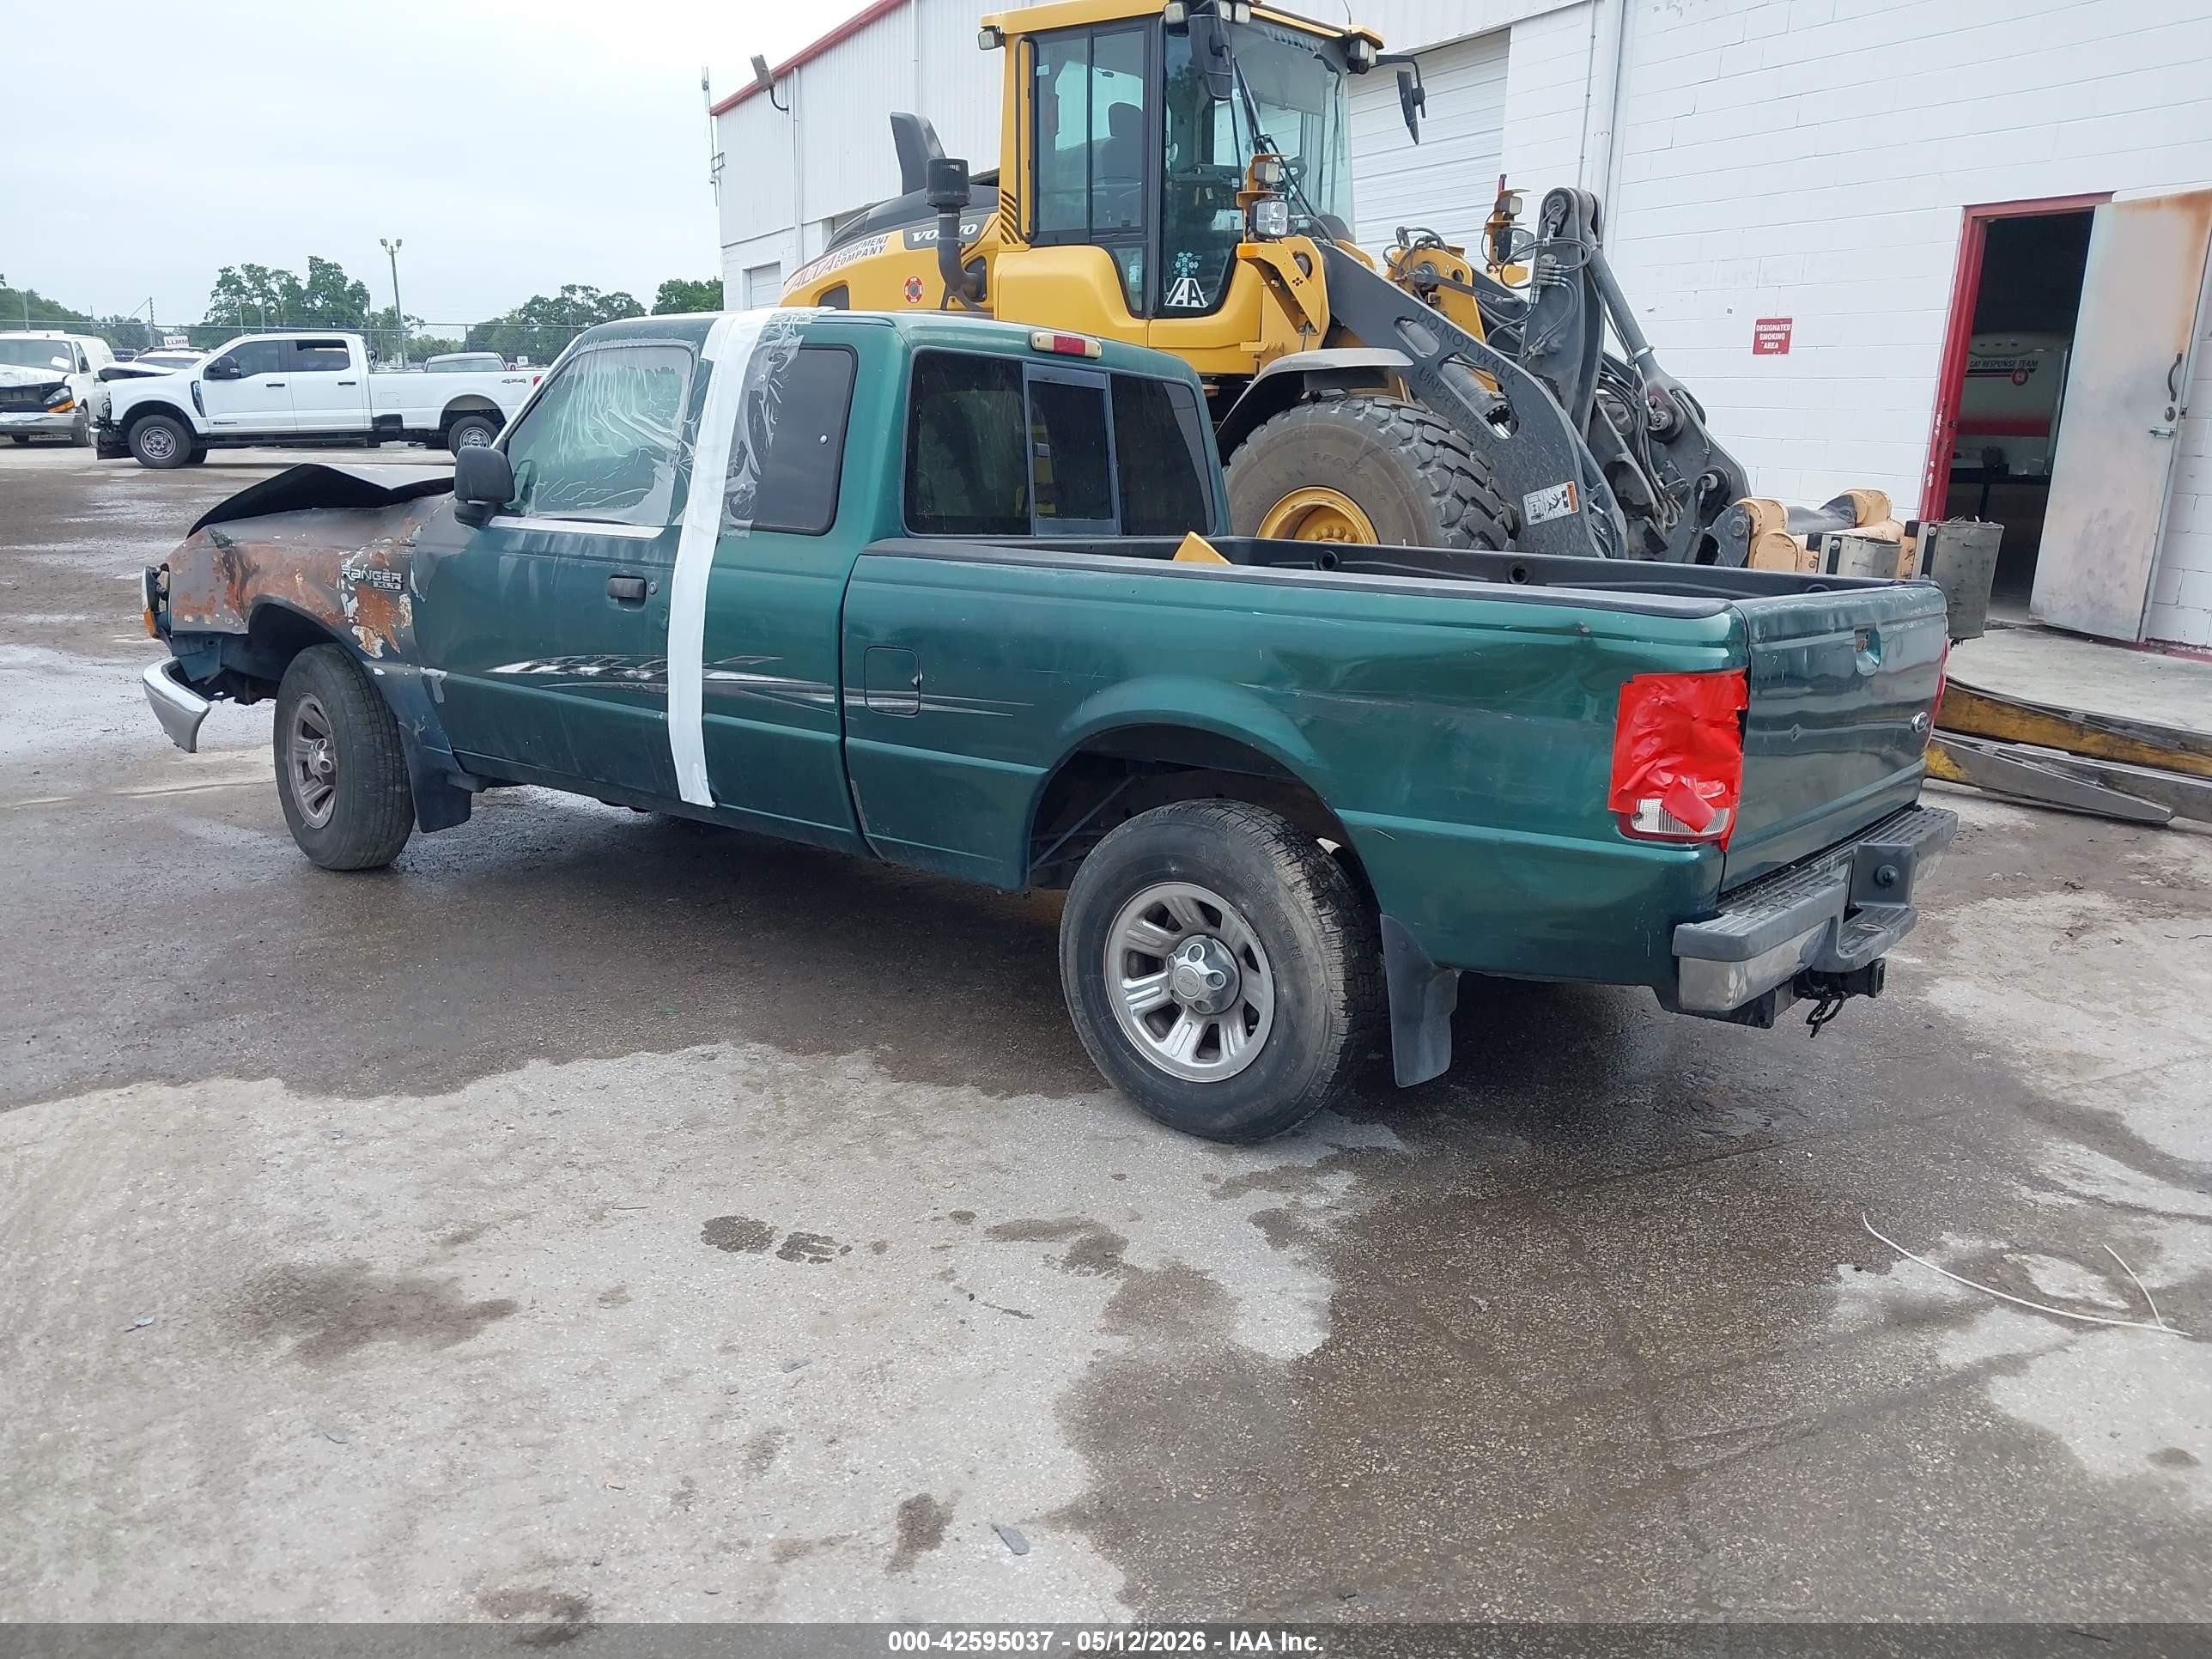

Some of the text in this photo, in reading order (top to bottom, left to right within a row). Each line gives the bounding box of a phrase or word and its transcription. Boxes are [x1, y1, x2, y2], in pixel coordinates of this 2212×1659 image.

[912, 223, 978, 242] VOO
[838, 235, 890, 258] EQUIPMENT
[834, 245, 885, 268] COMPANY
[786, 253, 839, 295] ALTA
[1756, 323, 1791, 331] DESIGNATED
[1759, 332, 1785, 341] SMOKING
[1417, 309, 1518, 386] DO NOT WALK
[1982, 360, 2015, 368] RESPONSE
[341, 565, 403, 584] RANGER
[374, 581, 402, 590] XLT
[1243, 873, 1304, 961] SEASON
